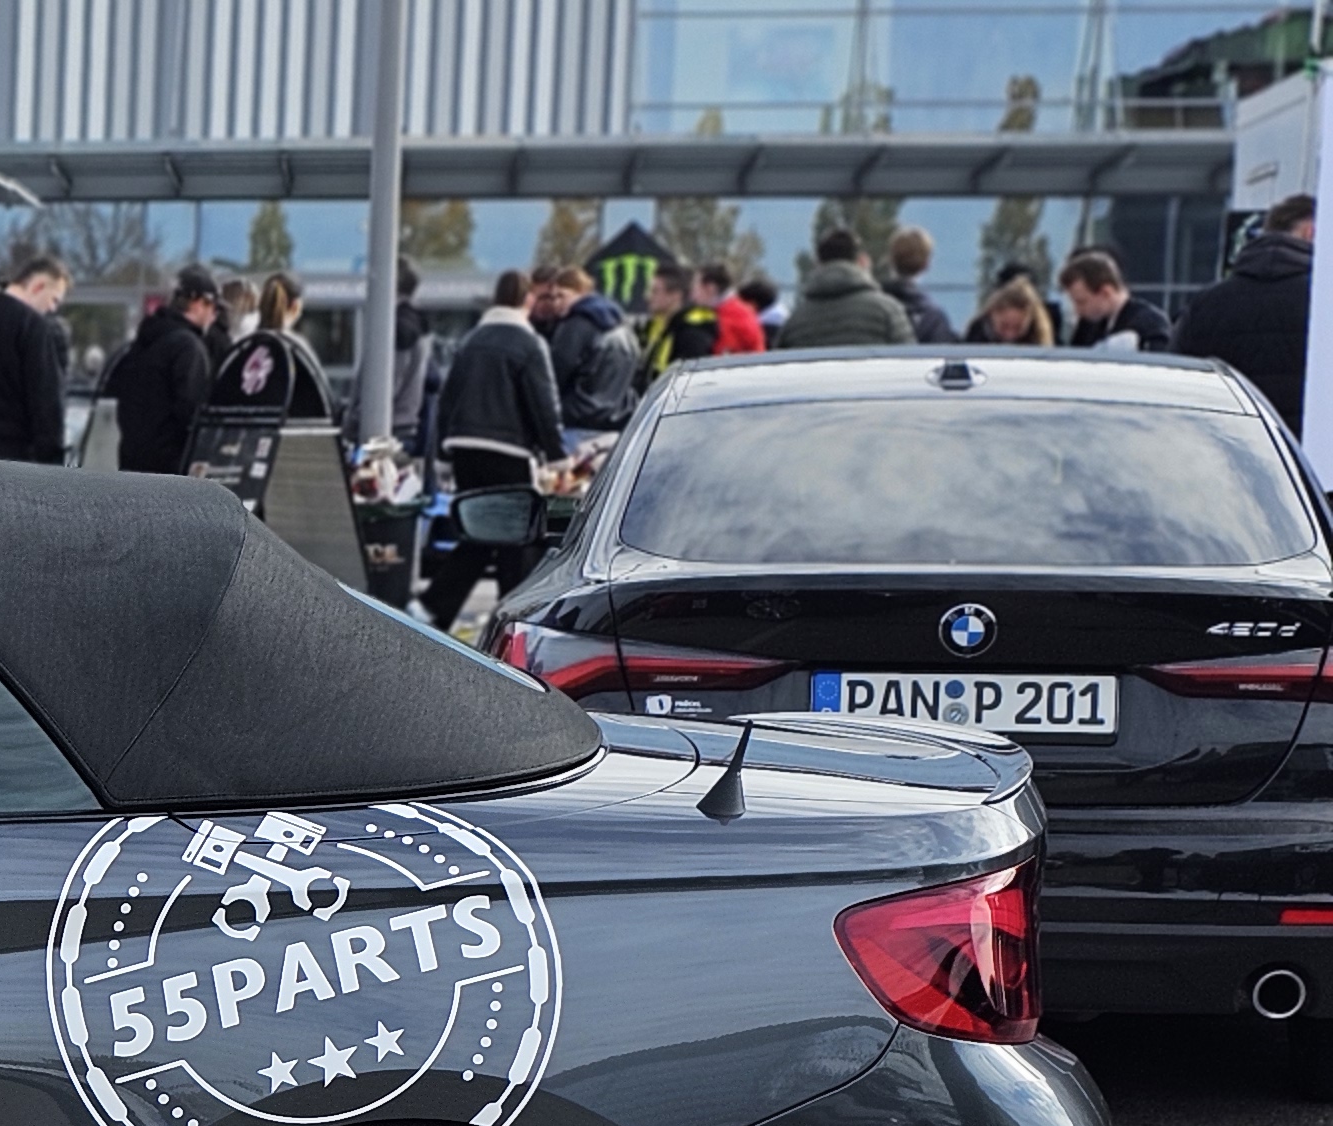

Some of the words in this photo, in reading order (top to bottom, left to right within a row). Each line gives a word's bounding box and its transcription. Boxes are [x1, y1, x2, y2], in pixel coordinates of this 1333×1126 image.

[846, 679, 941, 721] PAN
[974, 680, 1003, 724] P
[1015, 681, 1105, 726] 201
[109, 895, 501, 1058] 55PARTS
